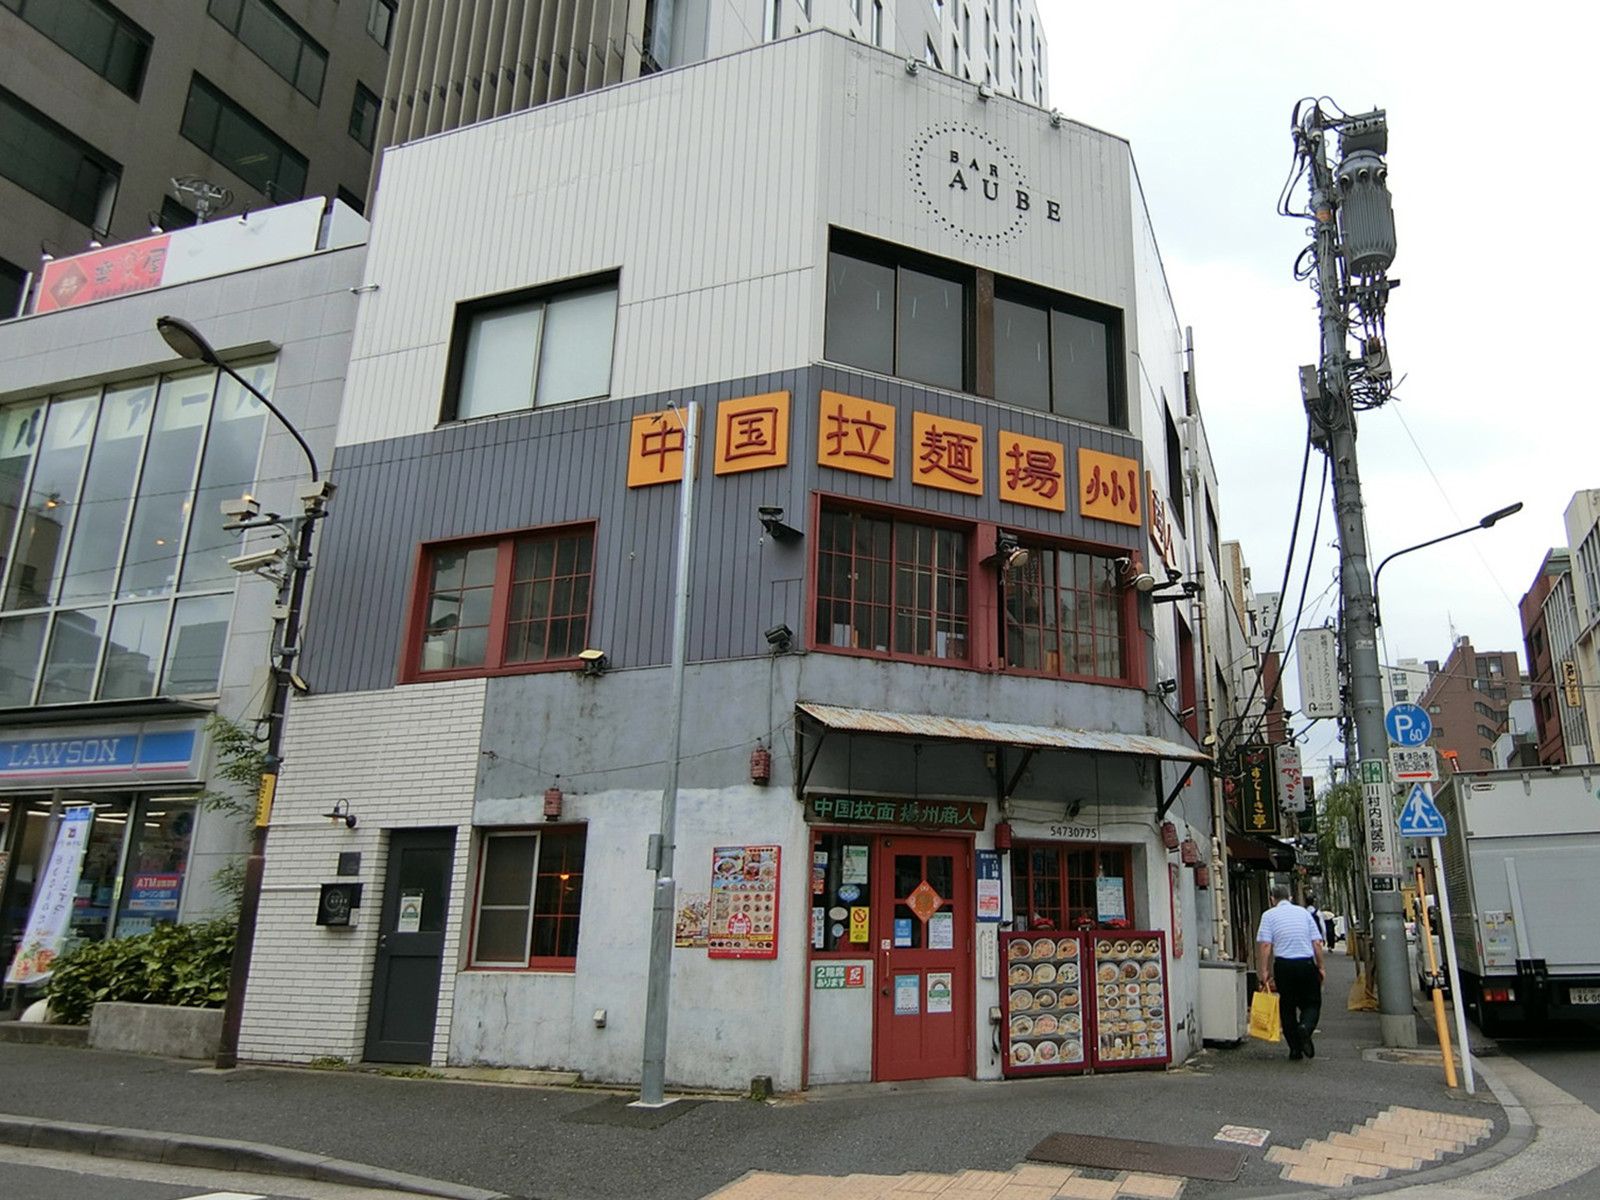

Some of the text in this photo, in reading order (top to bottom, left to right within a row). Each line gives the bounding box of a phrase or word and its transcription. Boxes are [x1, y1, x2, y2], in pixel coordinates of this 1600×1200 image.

[950, 150, 998, 177] BAR
[948, 169, 1061, 222] AUBE
[1409, 728, 1423, 742] 60
[8, 739, 120, 766] LAWSON
[1366, 785, 1386, 853] 川村内科医院
[1050, 825, 1097, 839] 54730775
[136, 877, 157, 888] ATM
[816, 978, 845, 988] あります
